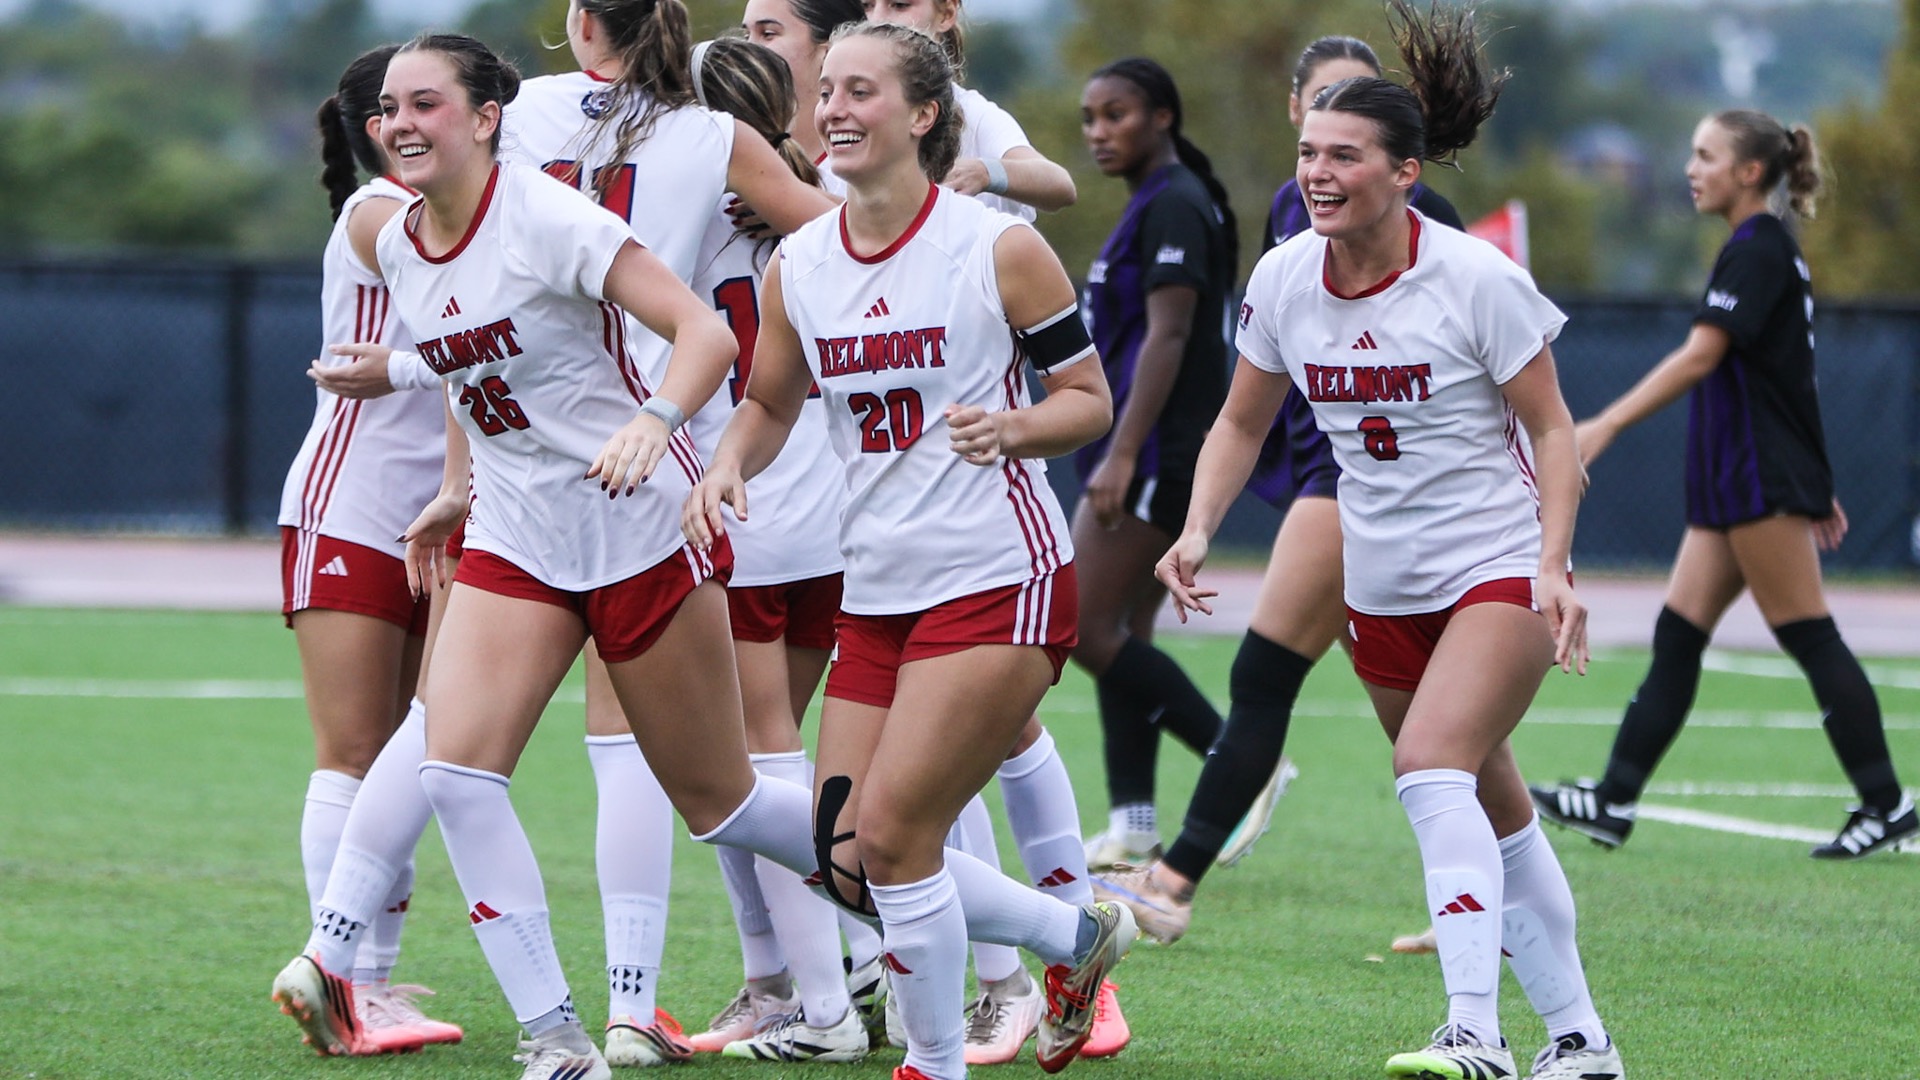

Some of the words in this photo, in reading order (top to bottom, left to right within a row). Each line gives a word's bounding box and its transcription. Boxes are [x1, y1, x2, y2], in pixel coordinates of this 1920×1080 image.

[814, 326, 947, 378] BELMONT
[459, 375, 531, 437] 26
[1303, 363, 1433, 405] BELMONT
[847, 387, 924, 453] 20
[1357, 416, 1402, 461] 8
